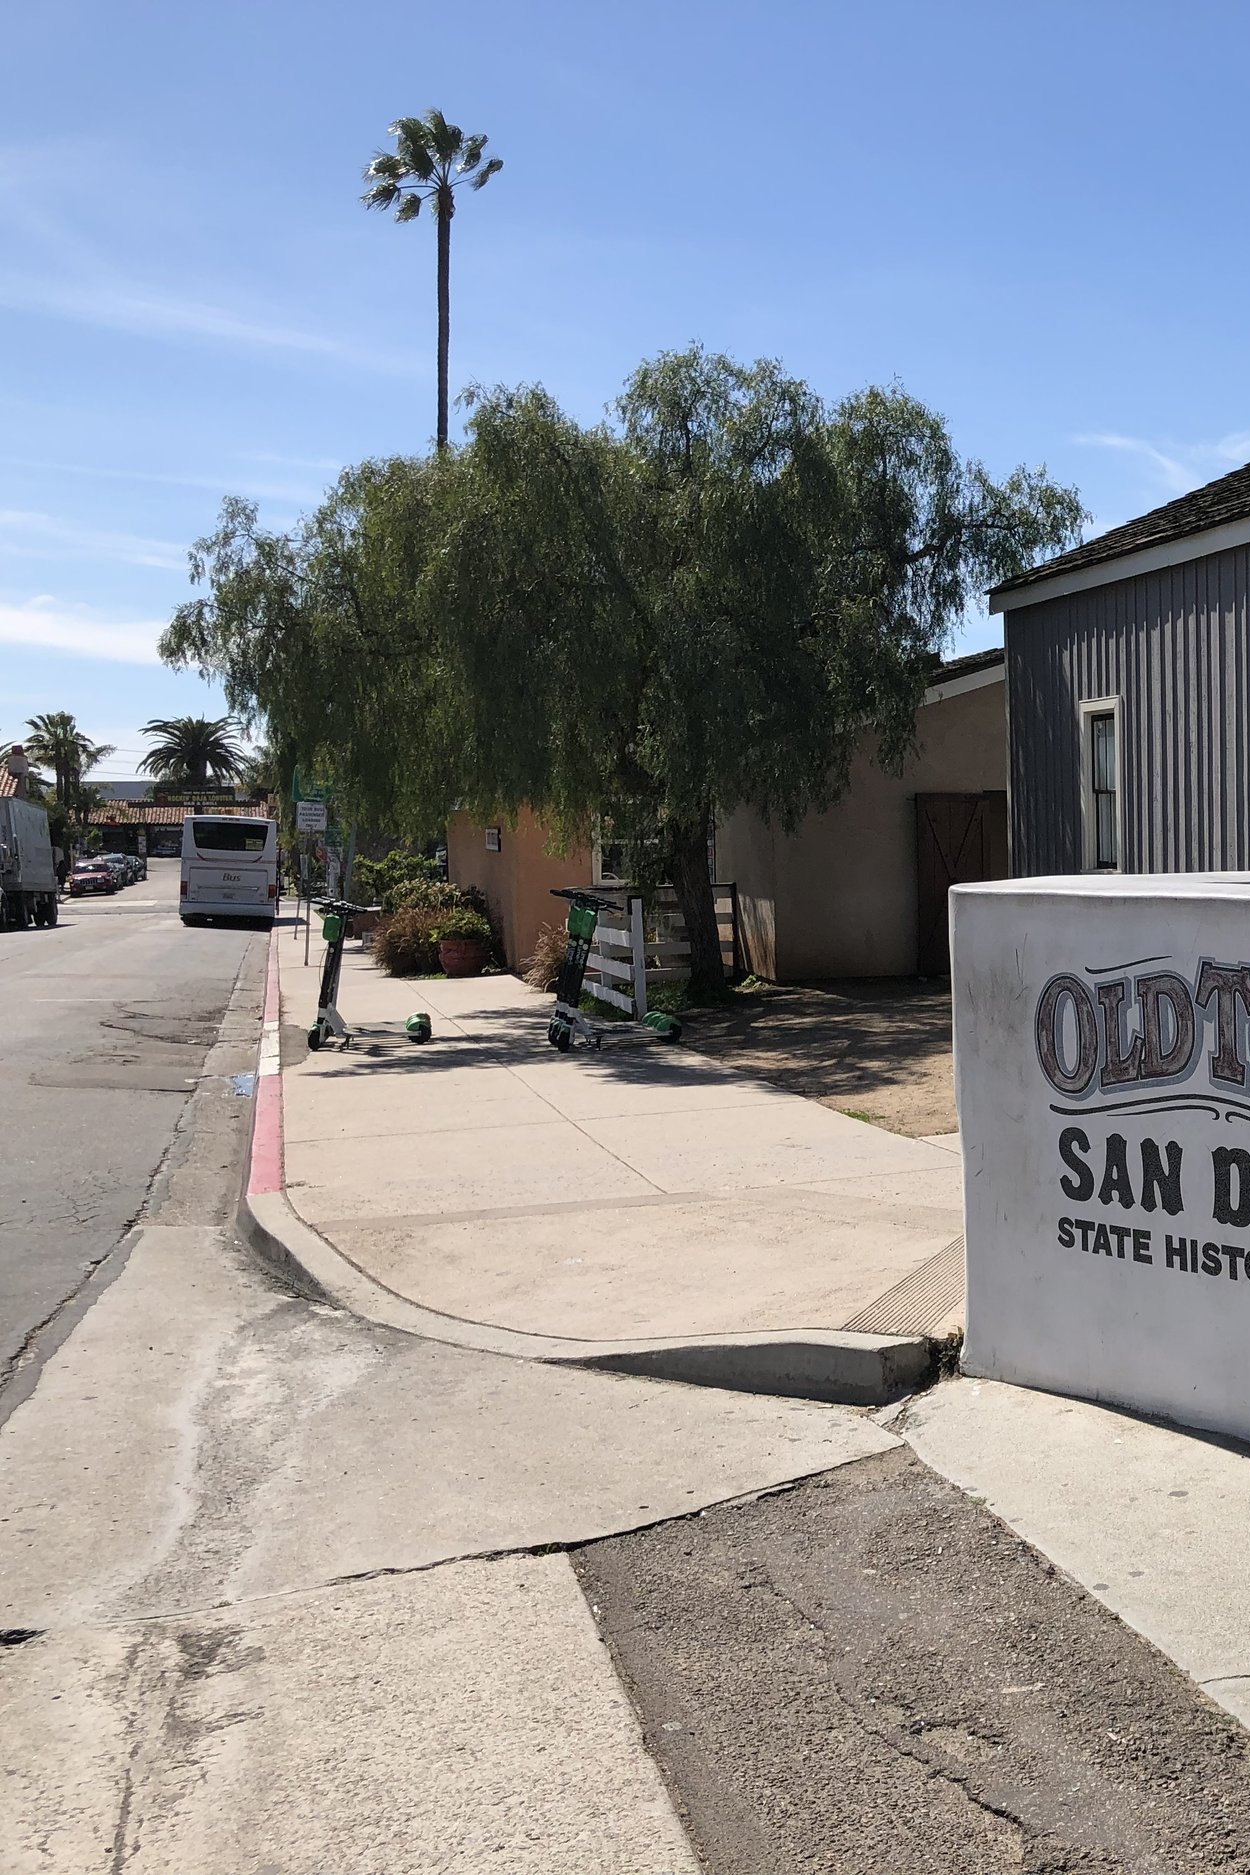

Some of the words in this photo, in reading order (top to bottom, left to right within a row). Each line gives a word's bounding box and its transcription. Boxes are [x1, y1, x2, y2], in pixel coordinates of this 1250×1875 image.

[223, 873, 240, 881] Bus
[1058, 1126, 1184, 1215] SAN
[1057, 1216, 1153, 1265] STATE
